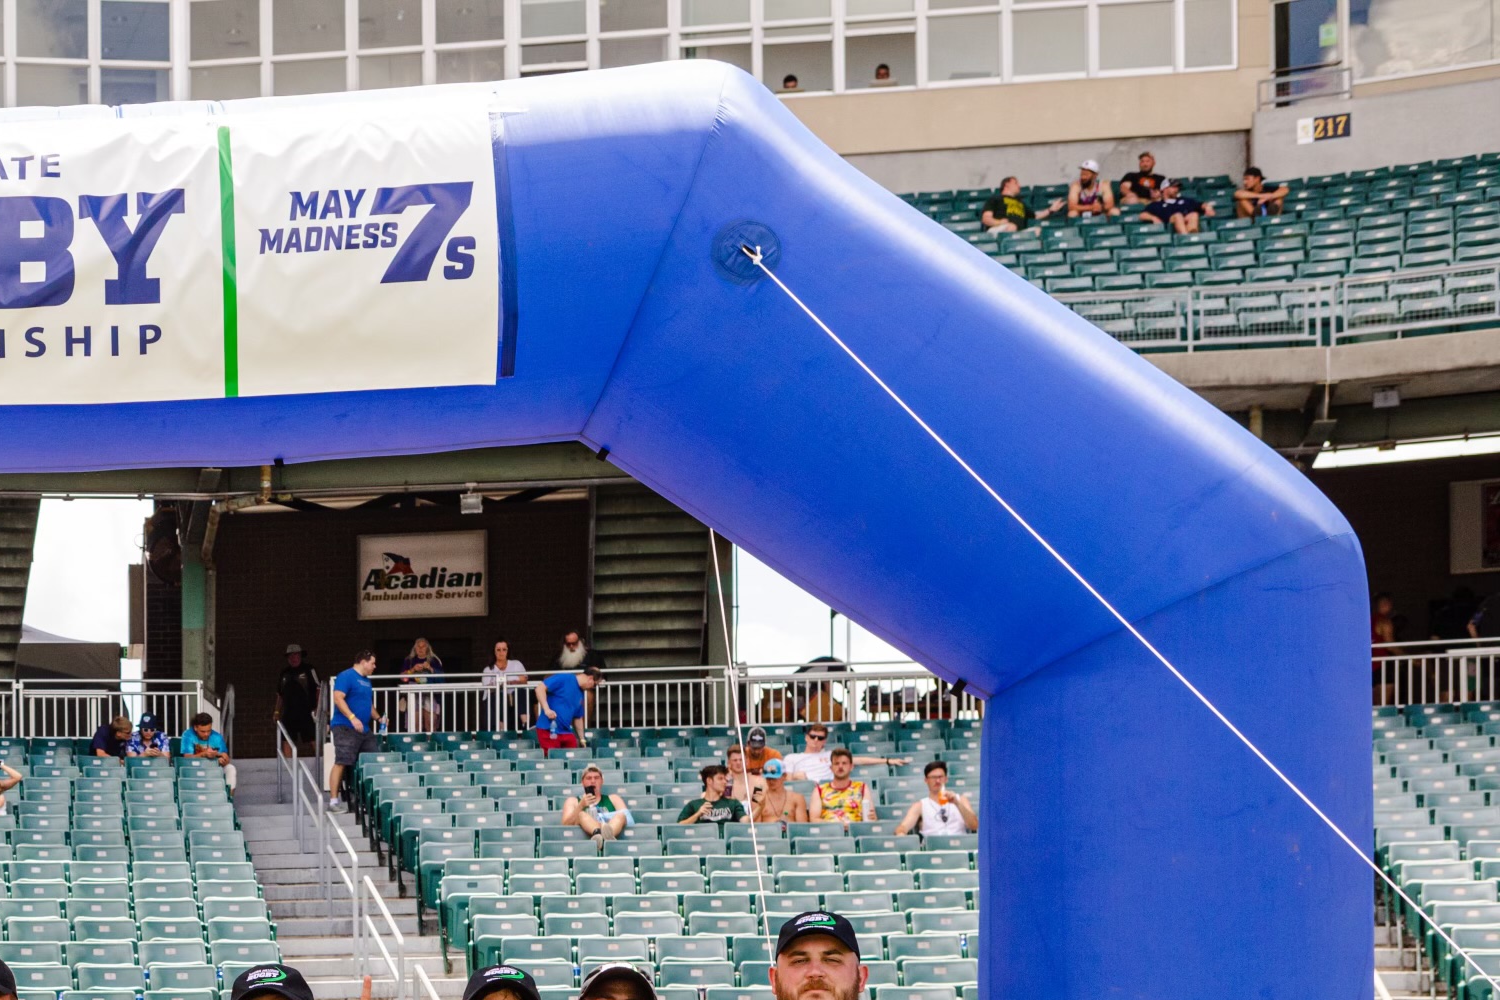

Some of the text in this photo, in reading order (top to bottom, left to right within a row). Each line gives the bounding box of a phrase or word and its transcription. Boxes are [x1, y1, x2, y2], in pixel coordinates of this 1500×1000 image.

[1314, 115, 1348, 138] 217
[289, 189, 366, 221] MAY
[259, 222, 398, 254] MADNESS
[362, 566, 483, 590] Acadian
[362, 589, 483, 602] Ambulance Service
